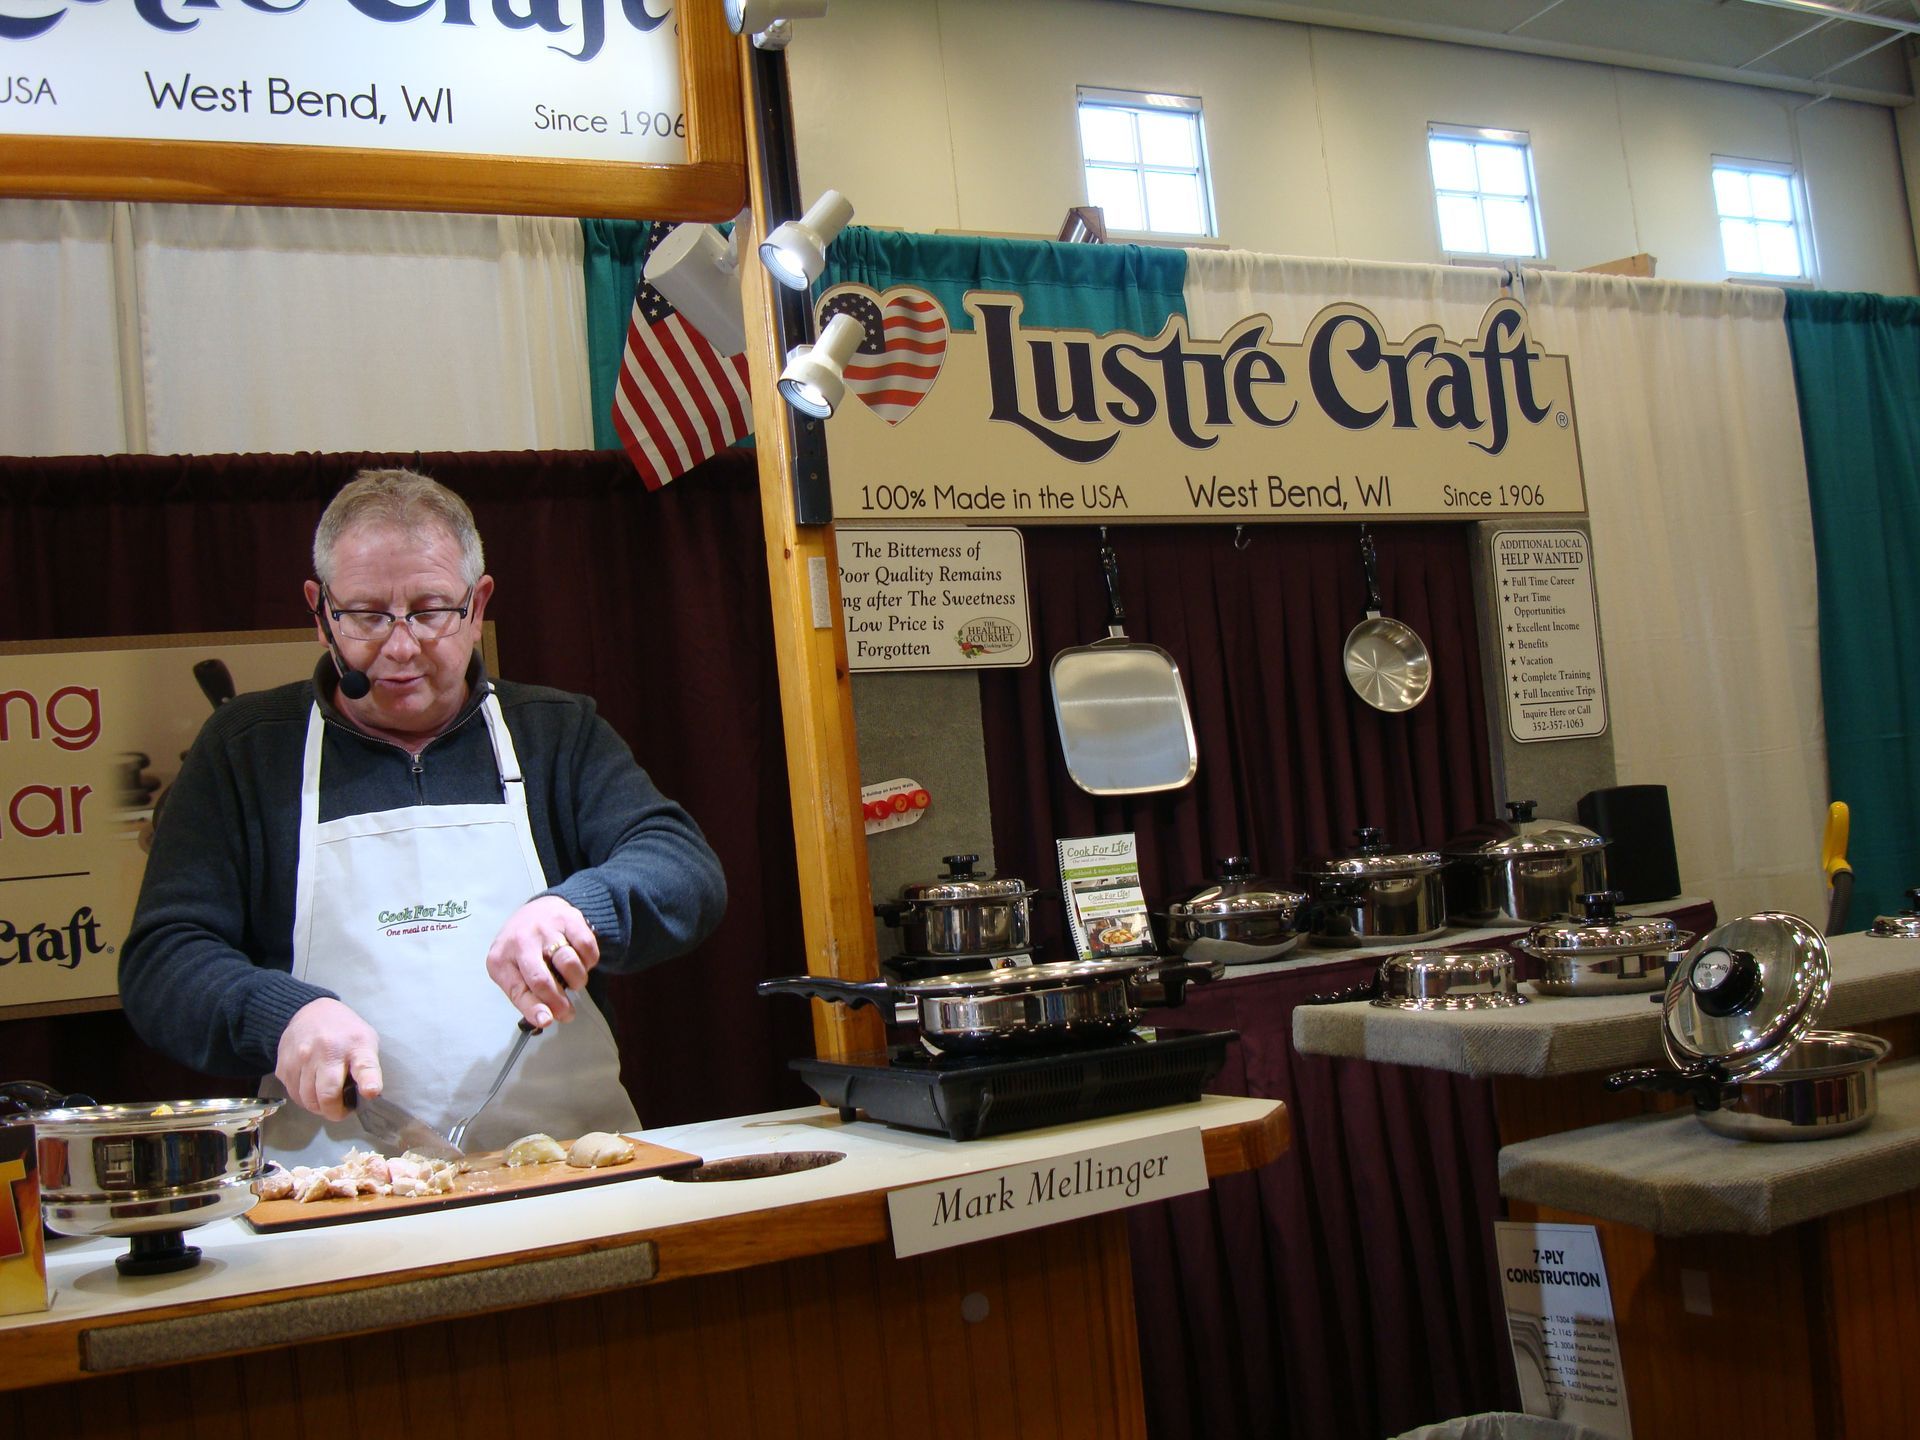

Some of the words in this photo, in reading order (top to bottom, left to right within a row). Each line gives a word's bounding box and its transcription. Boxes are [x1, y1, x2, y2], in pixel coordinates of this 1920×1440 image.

[144, 70, 252, 114] West
[268, 76, 387, 125] Bend,
[400, 84, 453, 124] WI
[534, 104, 608, 133] Since
[619, 109, 685, 138] 1906
[974, 303, 1298, 463] Lustre
[1308, 308, 1553, 456] Craft
[861, 484, 926, 510] 100%
[934, 484, 1006, 510] Made
[1013, 488, 1032, 510] in
[1038, 484, 1074, 510] the
[1081, 484, 1129, 509] USA
[1185, 475, 1258, 508] West
[1267, 475, 1348, 511] Bend,
[1355, 475, 1392, 507] WI
[1443, 484, 1492, 507] Since
[1499, 484, 1545, 507] 1906
[852, 541, 882, 558] The
[887, 541, 962, 558] Bitterness
[966, 540, 981, 561] of
[1500, 540, 1554, 550] ADDITIONAL
[1555, 539, 1583, 549] LOCAL
[1501, 552, 1530, 566] HELP
[1532, 551, 1584, 565] WANTED
[875, 565, 933, 586] Quality
[939, 565, 1002, 582] Remains
[1511, 576, 1527, 587] Full
[1528, 576, 1549, 587] Time
[1550, 575, 1575, 586] Career
[866, 590, 903, 611] after
[907, 590, 937, 606] The
[942, 590, 1016, 606] Sweetness
[1513, 593, 1529, 603] Part
[1531, 592, 1551, 603] Time
[1514, 606, 1566, 619] Opportunities
[848, 616, 882, 633] Low
[888, 615, 927, 632] Price
[933, 615, 945, 631] is
[968, 626, 1012, 635] HEALTHY
[1516, 622, 1551, 633] Excellent
[1552, 621, 1580, 632] Income
[966, 633, 1015, 643] GOURMET
[1518, 639, 1549, 650] Benefits
[856, 640, 930, 660] Forgotten
[1519, 656, 1554, 666] Vacation
[1521, 672, 1557, 684] Complete
[1558, 670, 1591, 681] Training
[1523, 689, 1538, 700] Full
[1540, 687, 1575, 698] Incentive
[1576, 686, 1596, 697] Trips
[1522, 708, 1548, 720] Inquire
[1549, 707, 1567, 718] Here
[1568, 708, 1576, 716] or
[1577, 705, 1591, 715] Call
[1532, 719, 1584, 732] 352-357-1063
[1067, 845, 1090, 857] Cook
[1092, 845, 1109, 856] For
[1111, 839, 1133, 855] Life!
[378, 907, 413, 923] Cook
[414, 904, 437, 919] For
[437, 900, 467, 917] Life!
[402, 925, 420, 935] meal
[421, 924, 429, 932] at
[931, 1177, 1015, 1226] Mark
[1026, 1154, 1169, 1205] Mellinger
[1532, 1249, 1565, 1265] 7-PLY
[1506, 1267, 1601, 1288] CONSTRUCTION
